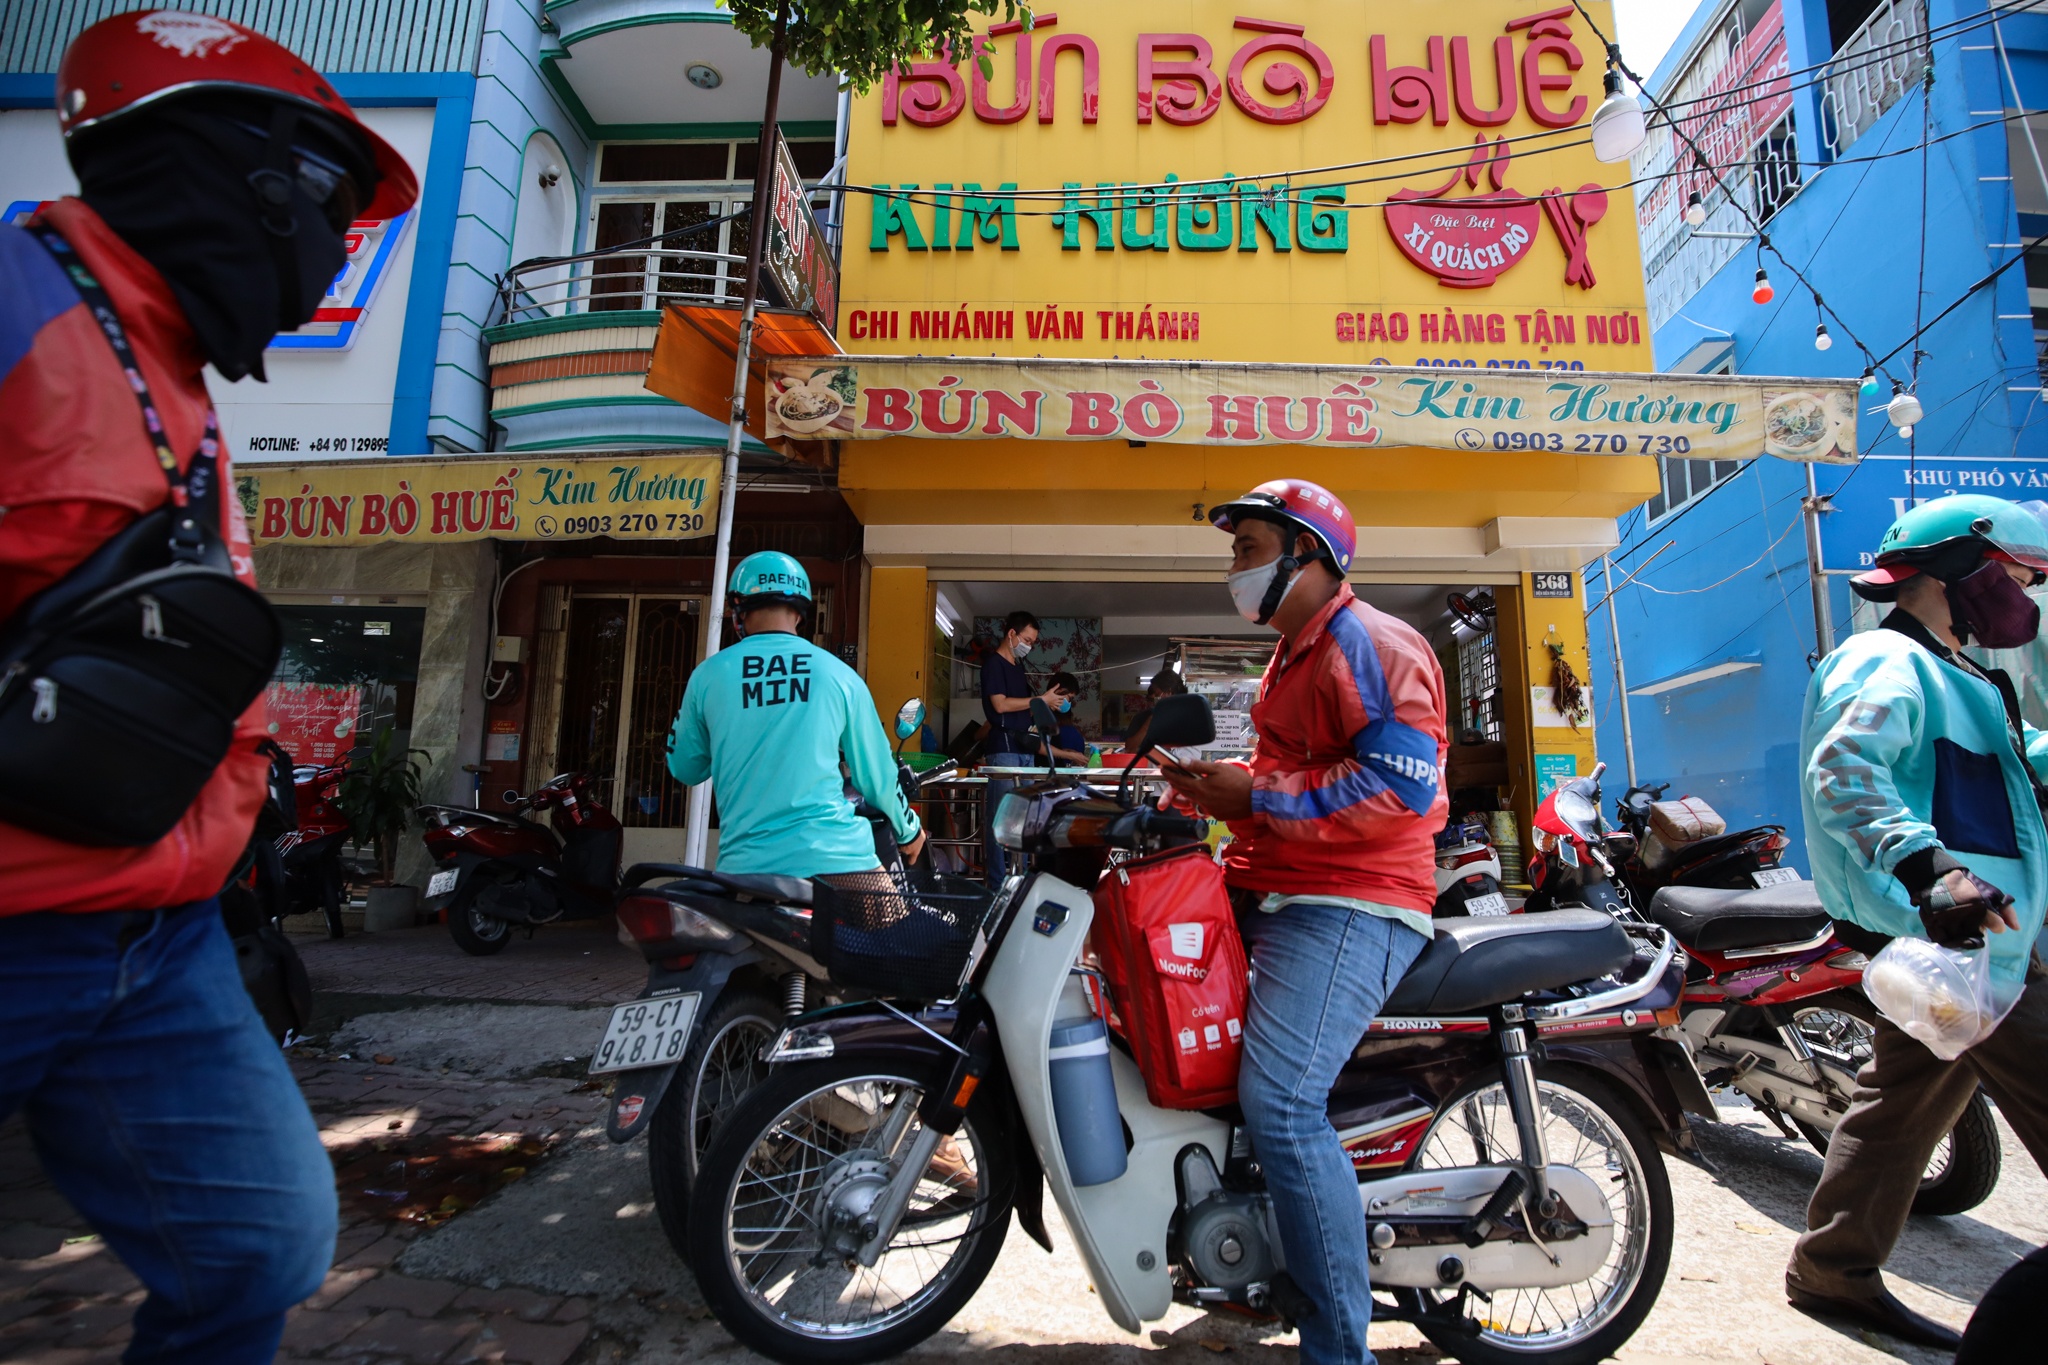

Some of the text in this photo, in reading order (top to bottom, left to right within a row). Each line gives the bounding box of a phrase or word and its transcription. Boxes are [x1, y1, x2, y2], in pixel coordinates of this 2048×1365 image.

[882, 5, 1588, 128] BÚN BÒ HUẾ
[869, 172, 1349, 254] KIM HƯƠNG
[1429, 213, 1496, 231] Đặc Biệt
[1429, 241, 1505, 271] QUÁCH
[1500, 221, 1530, 257] BÒ
[848, 303, 1200, 341] CHI NHÁNH VĂN THÁNH
[1335, 306, 1641, 352] GIAO HÀNG TẬN NƠI
[861, 375, 1745, 444] BÚN BÒ HUẾ Kim Hương
[249, 437, 300, 451] HOTLINE:
[310, 438, 330, 452] +84
[333, 438, 348, 451] 90
[1492, 431, 1692, 454] 0903 270 730
[1903, 469, 1952, 486] KHU
[1958, 467, 2005, 487] PHỐ
[259, 484, 351, 539] BÚN
[359, 480, 420, 536] BÒ
[430, 468, 521, 533] HUẾ
[529, 467, 599, 506] Kim
[607, 465, 709, 511] Hương
[564, 513, 704, 535] 0903 270 730
[758, 573, 807, 591] BAEMIN
[1536, 574, 1569, 590] 568
[742, 653, 812, 679] BAE
[742, 677, 811, 709] MIN
[1368, 752, 1437, 787] HIPP
[1470, 895, 1500, 912] 59-S1
[1158, 957, 1208, 979] NowFoo
[617, 999, 683, 1034] 59-C1
[1191, 1004, 1221, 1018] Có trên
[1382, 1019, 1443, 1030] HONDA
[1543, 1019, 1608, 1032] ELECTRIC STARTER
[597, 1029, 683, 1068] 948.18
[1207, 1042, 1222, 1051] Now
[1346, 1147, 1390, 1159] eam
